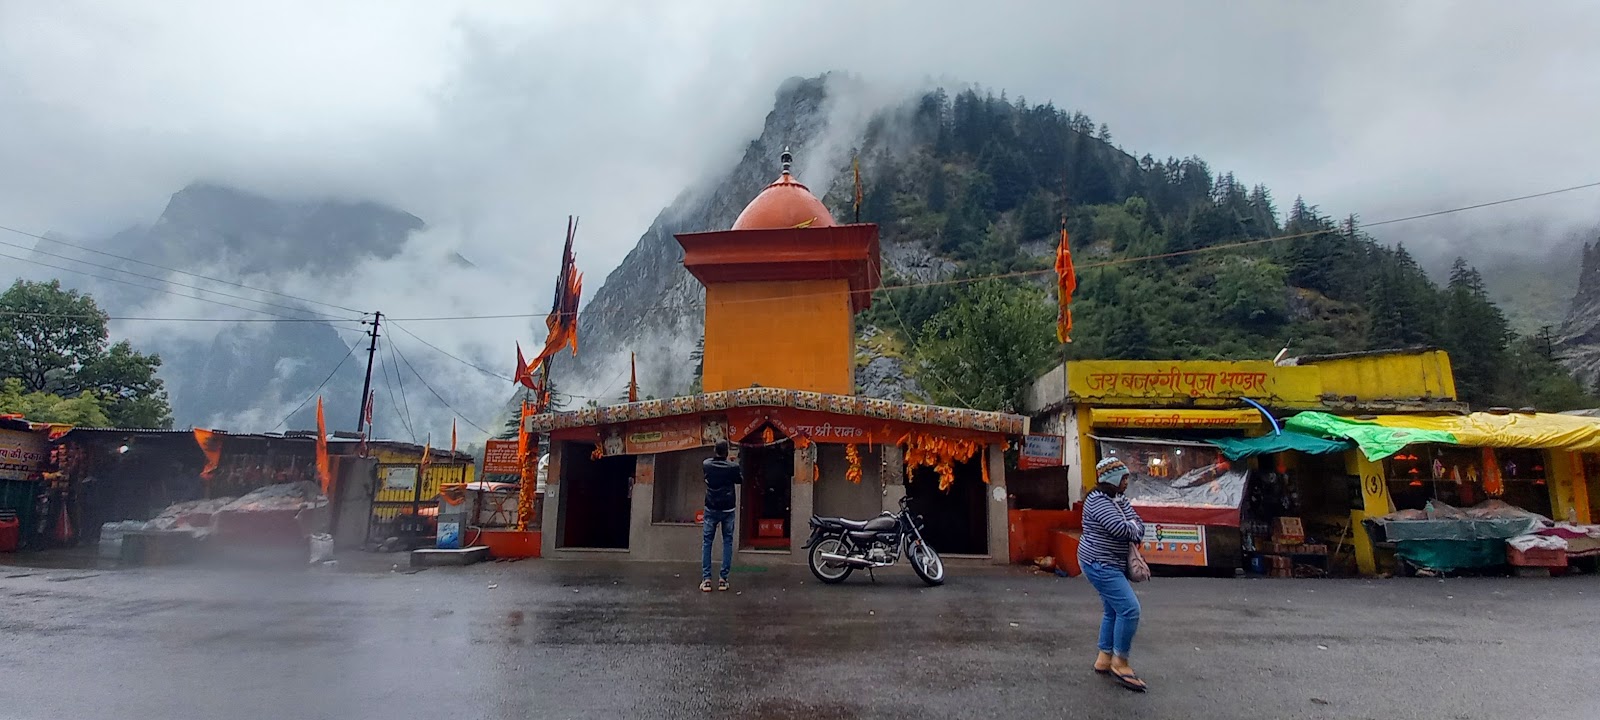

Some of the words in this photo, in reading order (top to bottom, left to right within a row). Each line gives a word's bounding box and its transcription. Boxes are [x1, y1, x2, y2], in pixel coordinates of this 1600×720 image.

[1086, 373, 1119, 391] जय
[1121, 366, 1181, 394] बजरंगी
[1183, 372, 1218, 396] पूजा
[1220, 371, 1267, 393] भण्डार
[815, 422, 832, 437] श्री
[834, 426, 855, 438] राम
[1365, 473, 1383, 498] (3)
